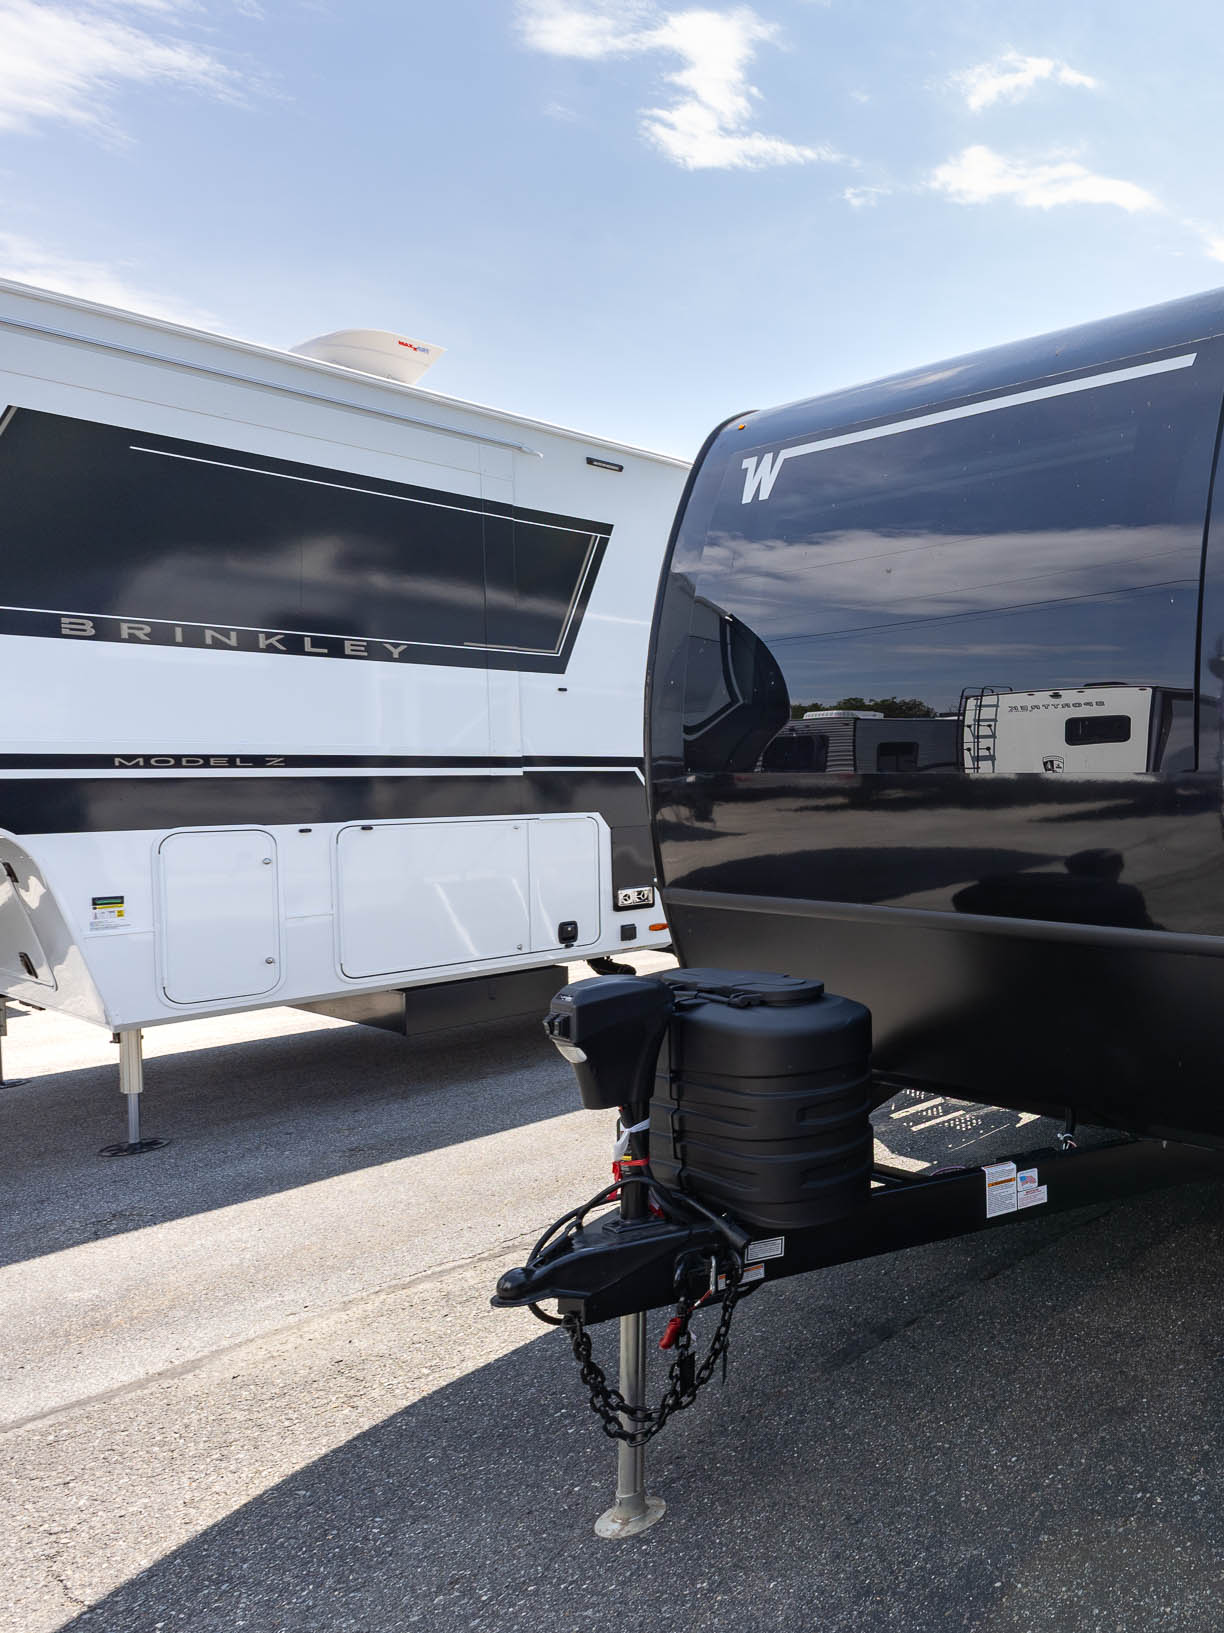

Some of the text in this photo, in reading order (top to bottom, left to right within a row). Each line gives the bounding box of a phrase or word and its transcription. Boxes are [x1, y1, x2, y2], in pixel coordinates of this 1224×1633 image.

[741, 450, 785, 504] W
[60, 617, 408, 659] BRINKLEY
[114, 757, 286, 767] MODEL Z
